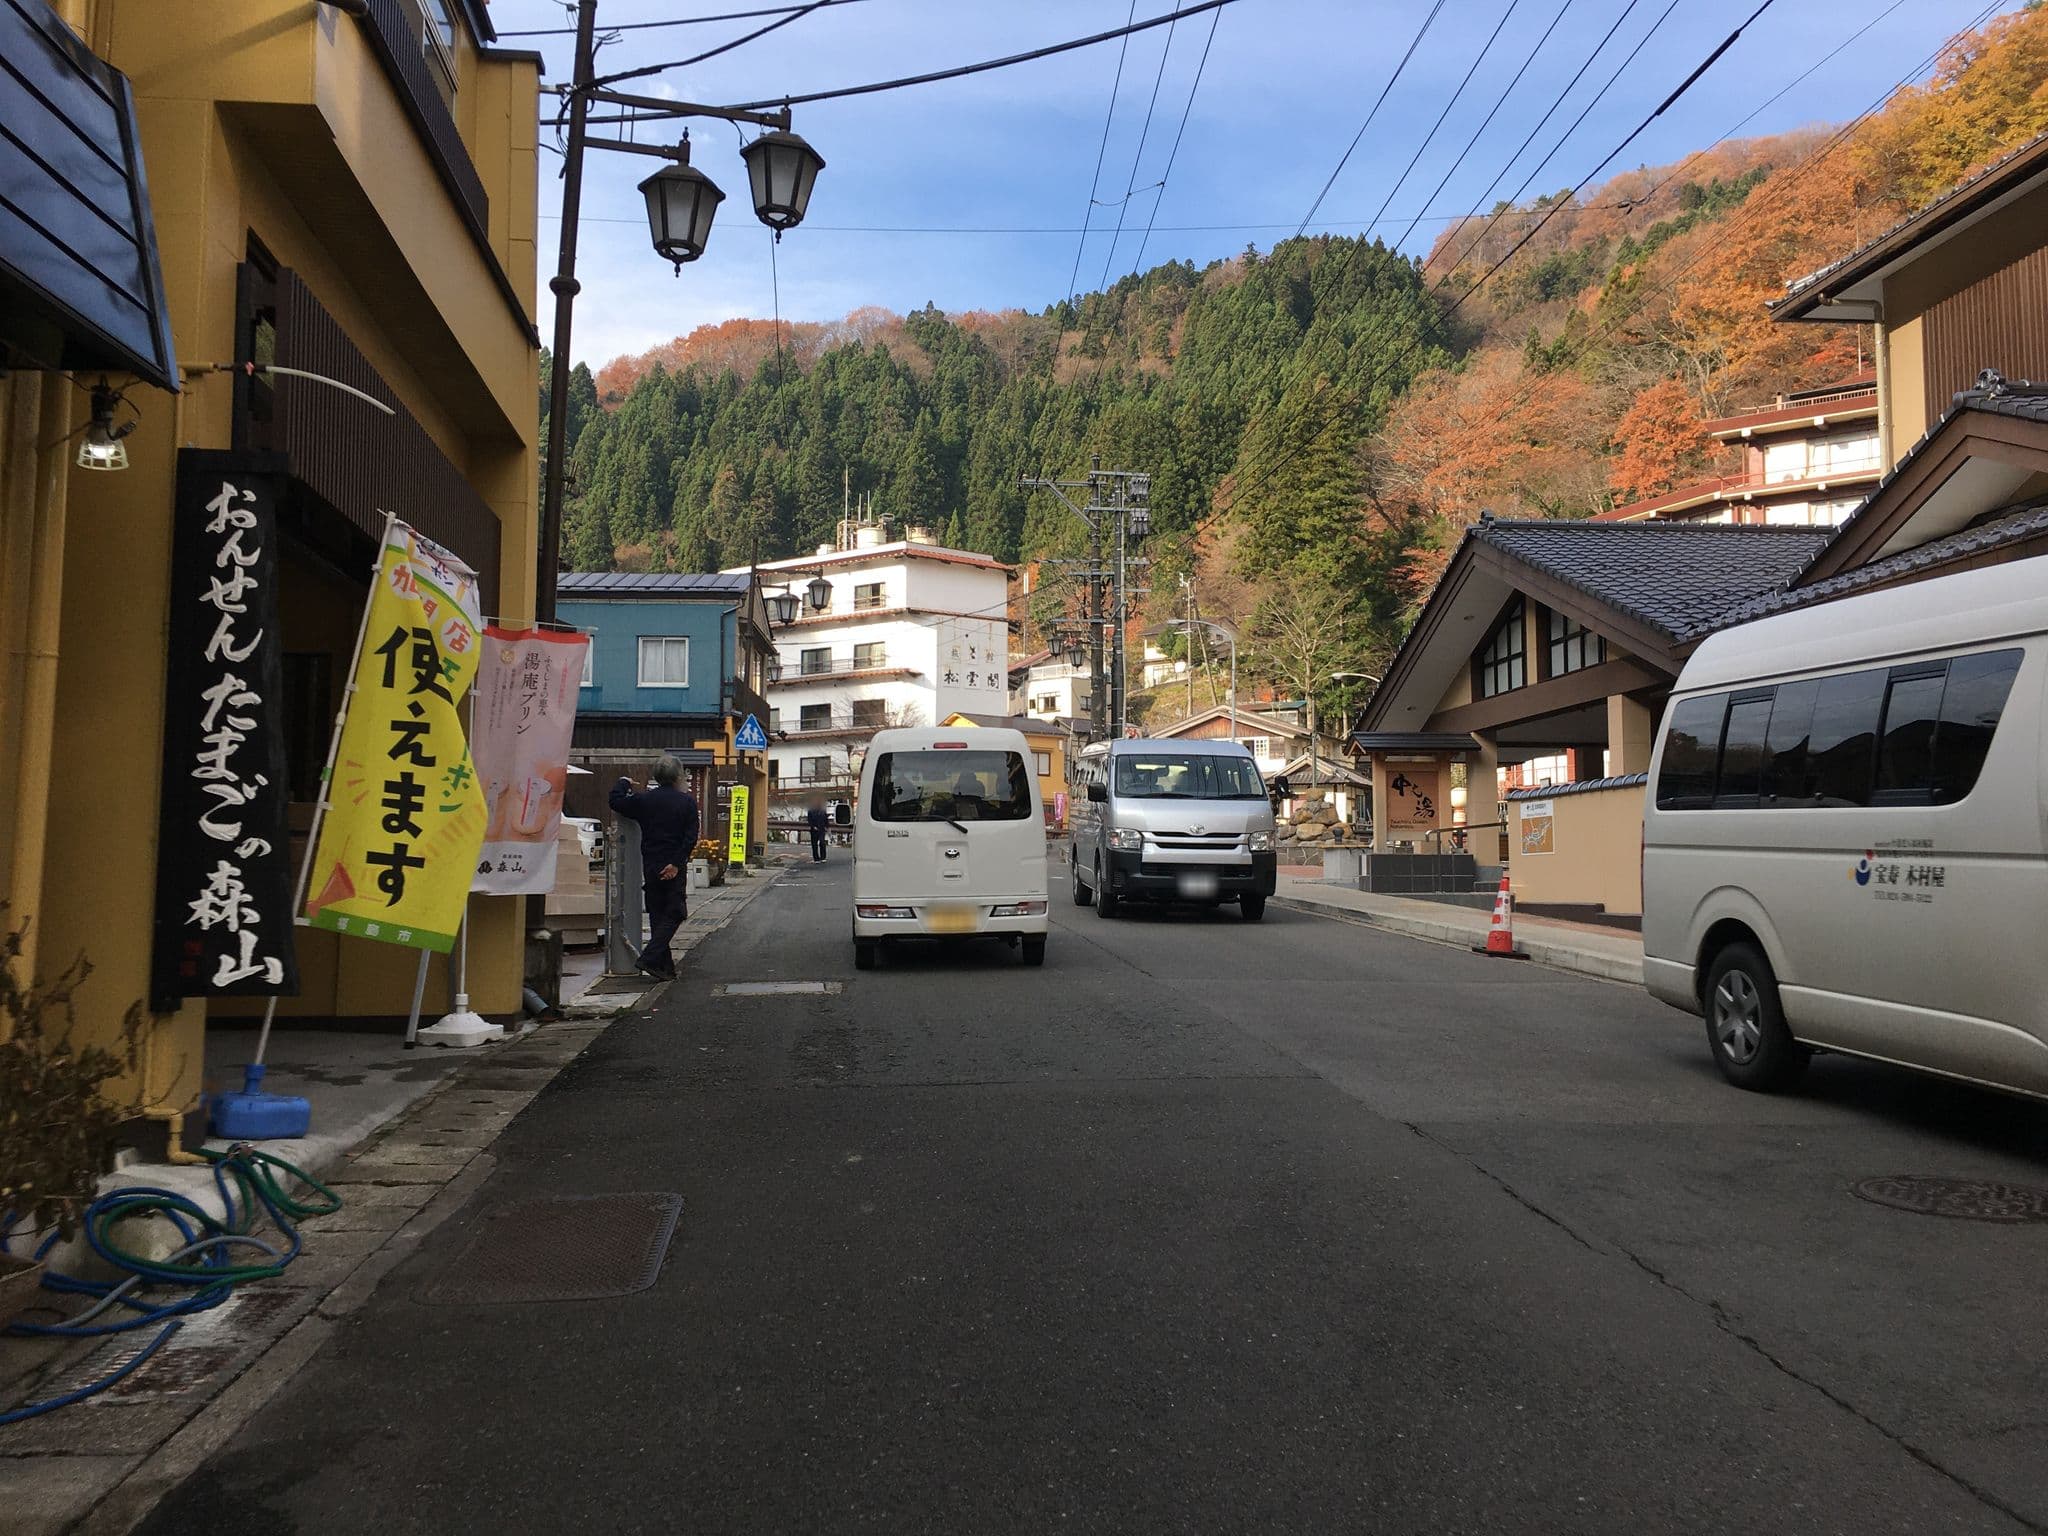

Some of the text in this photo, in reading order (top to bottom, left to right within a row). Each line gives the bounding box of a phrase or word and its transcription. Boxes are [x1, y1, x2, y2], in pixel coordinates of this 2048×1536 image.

[184, 481, 284, 988] おんせんたまごの森山
[733, 796, 745, 840] 左折工事中
